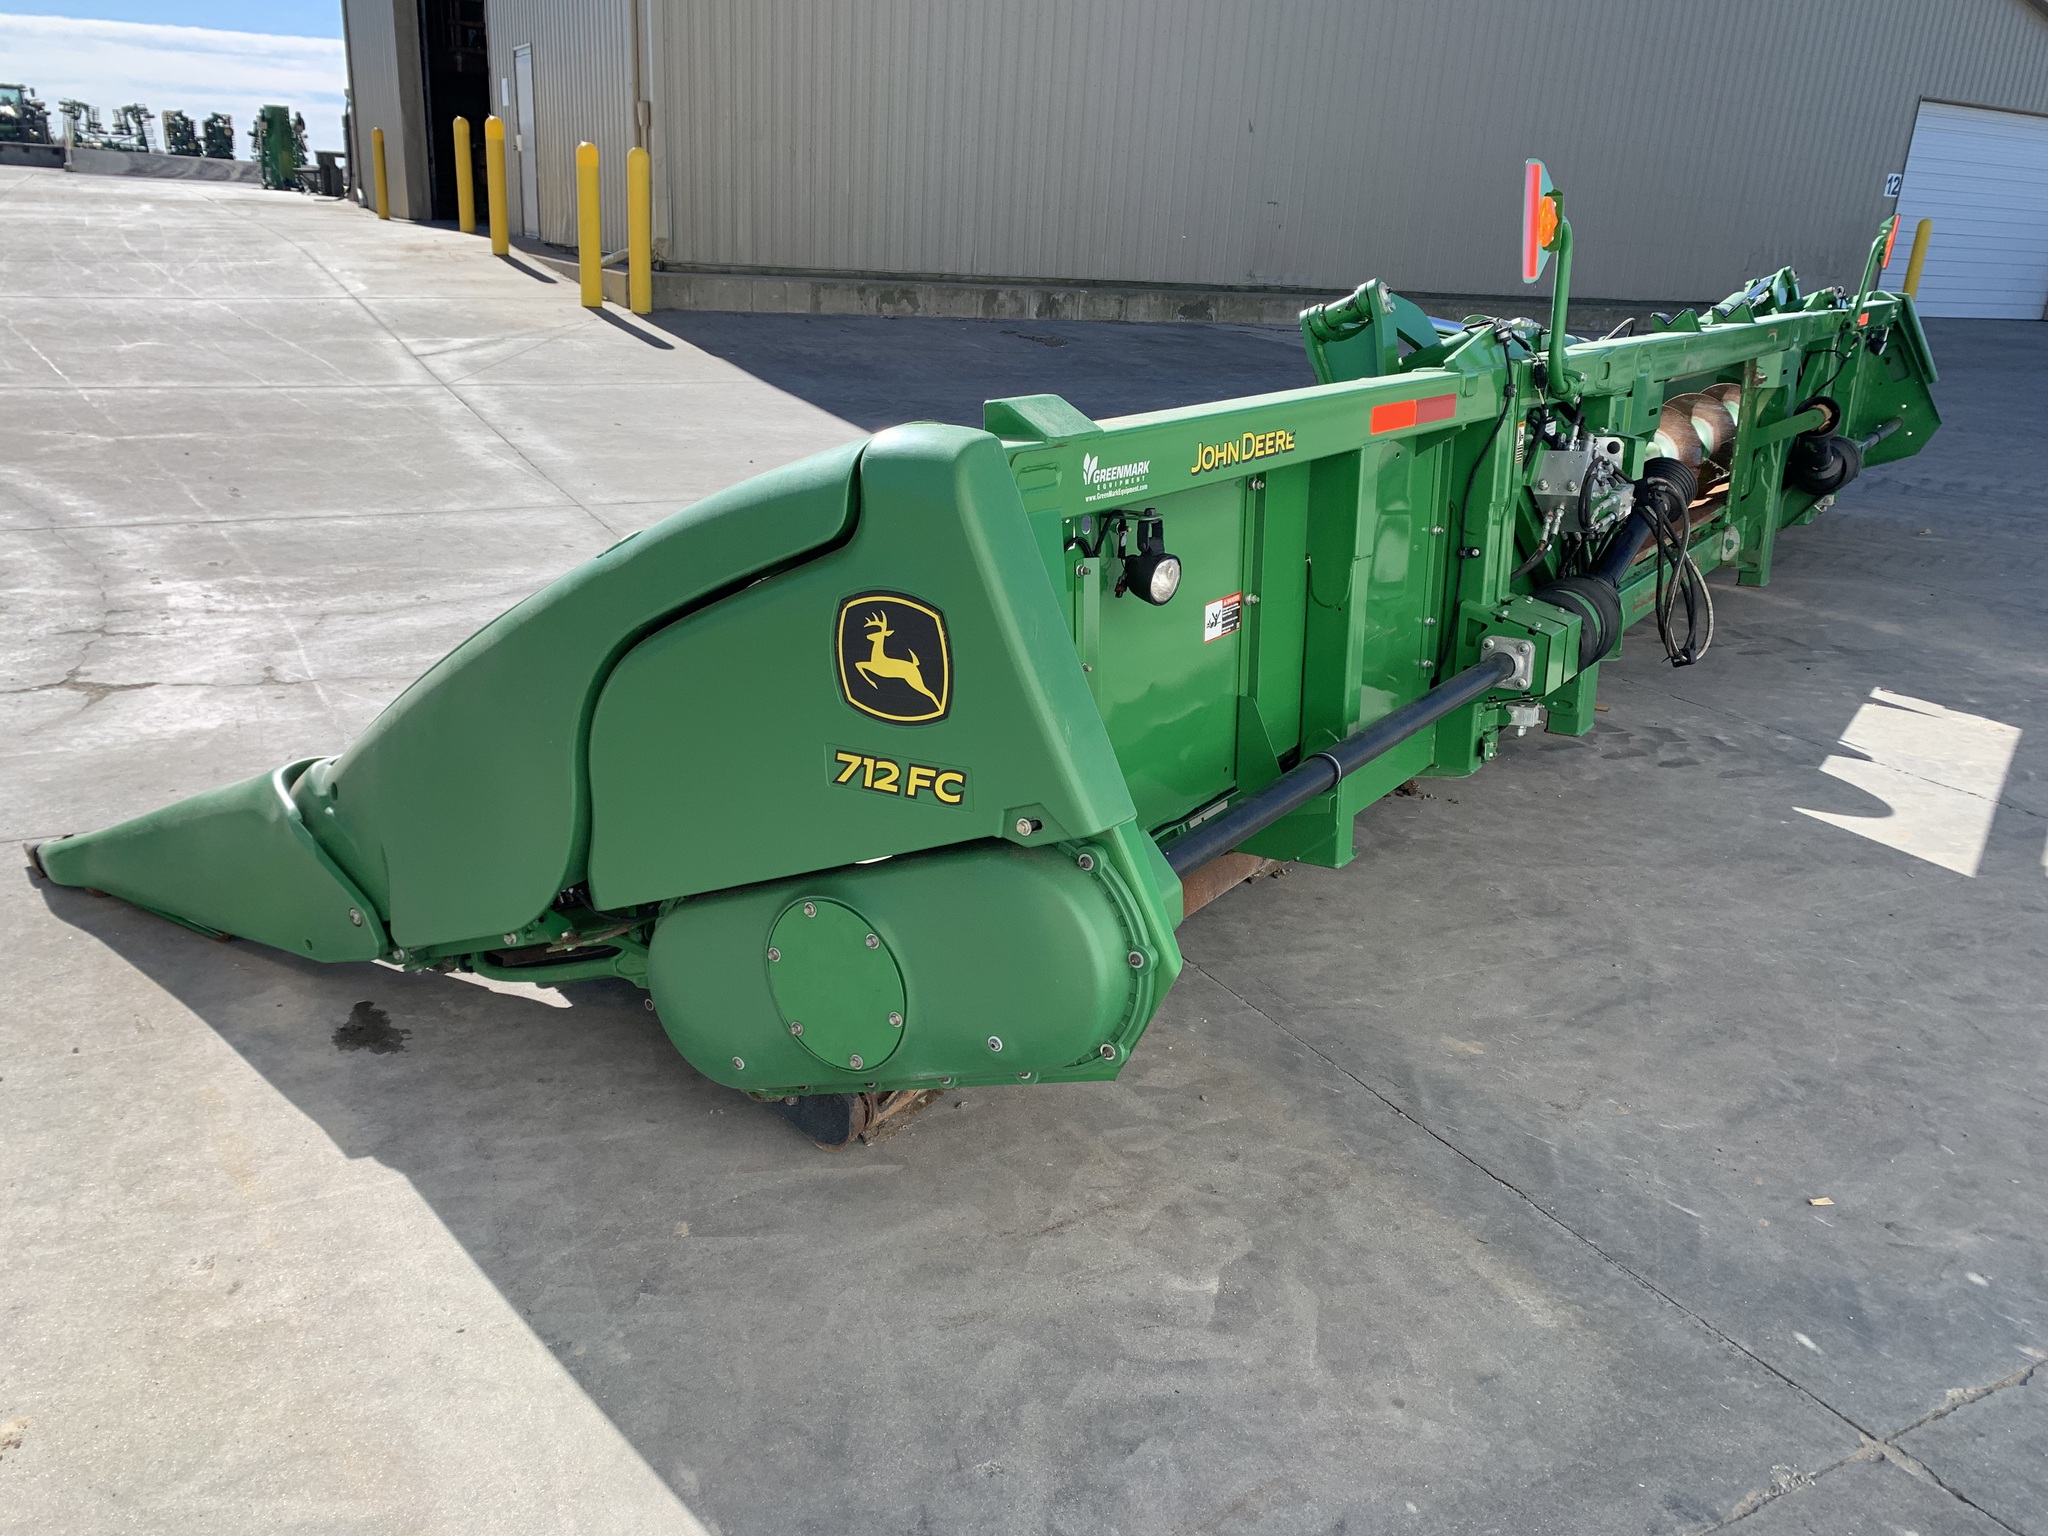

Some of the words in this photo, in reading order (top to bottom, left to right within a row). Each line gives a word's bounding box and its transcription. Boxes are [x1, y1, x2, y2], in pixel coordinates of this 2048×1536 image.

[1887, 175, 1900, 195] 12
[1191, 439, 1240, 476] JOHN
[1242, 429, 1296, 463] DEERE
[1092, 460, 1150, 484] GREENMARK
[1097, 475, 1146, 491] EQUIPMENT
[1085, 484, 1148, 503] www.GreenMarkEquipment.com
